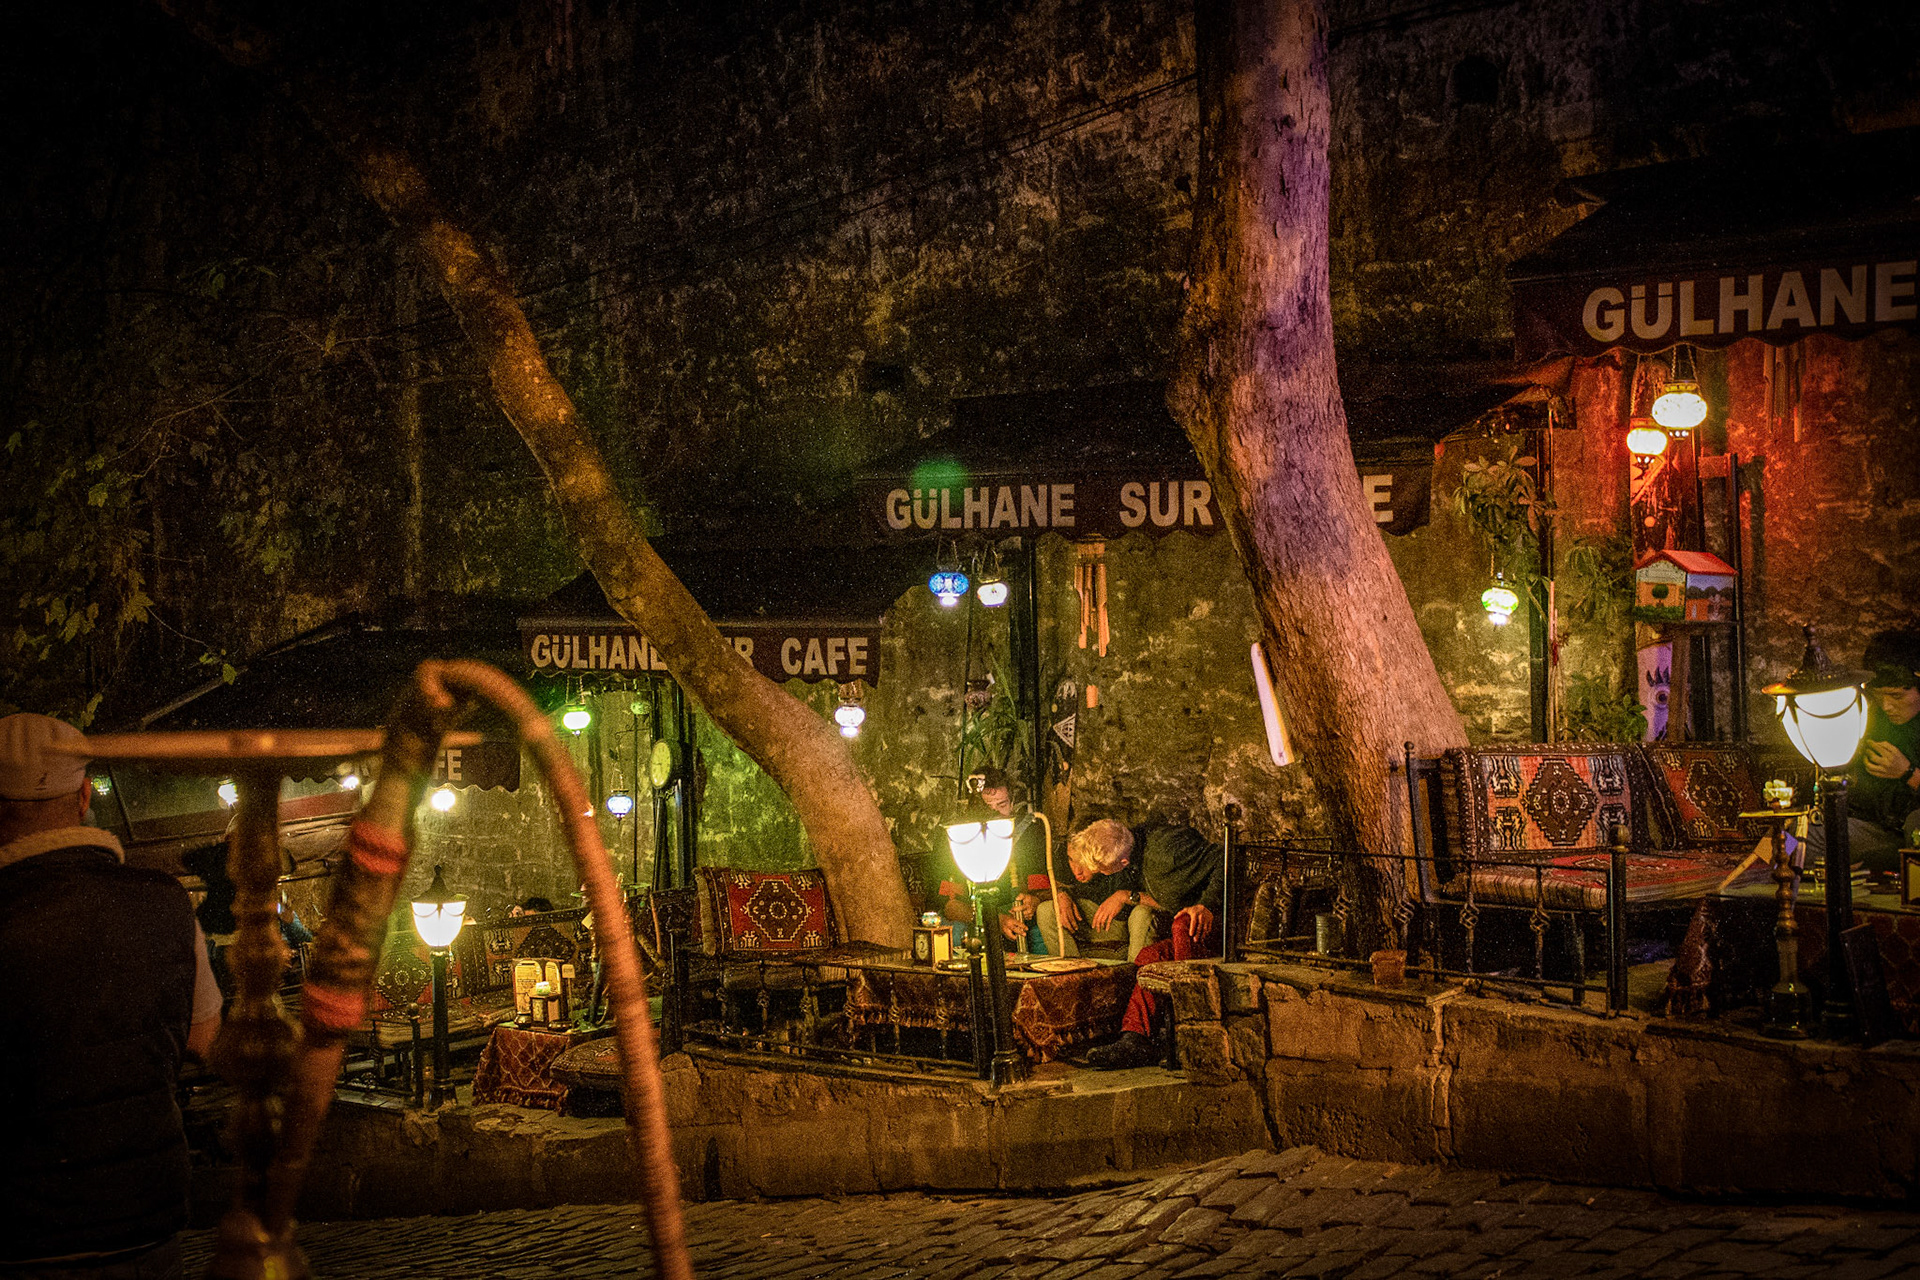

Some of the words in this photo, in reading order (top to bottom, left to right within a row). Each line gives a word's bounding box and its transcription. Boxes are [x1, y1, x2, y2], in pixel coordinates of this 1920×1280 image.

[1582, 261, 1918, 342] GÜLHANE
[885, 483, 1075, 530] GÜLHANE
[1119, 480, 1213, 526] SUR
[1362, 474, 1394, 522] E
[780, 637, 867, 675] CAFE
[436, 750, 462, 780] FE
